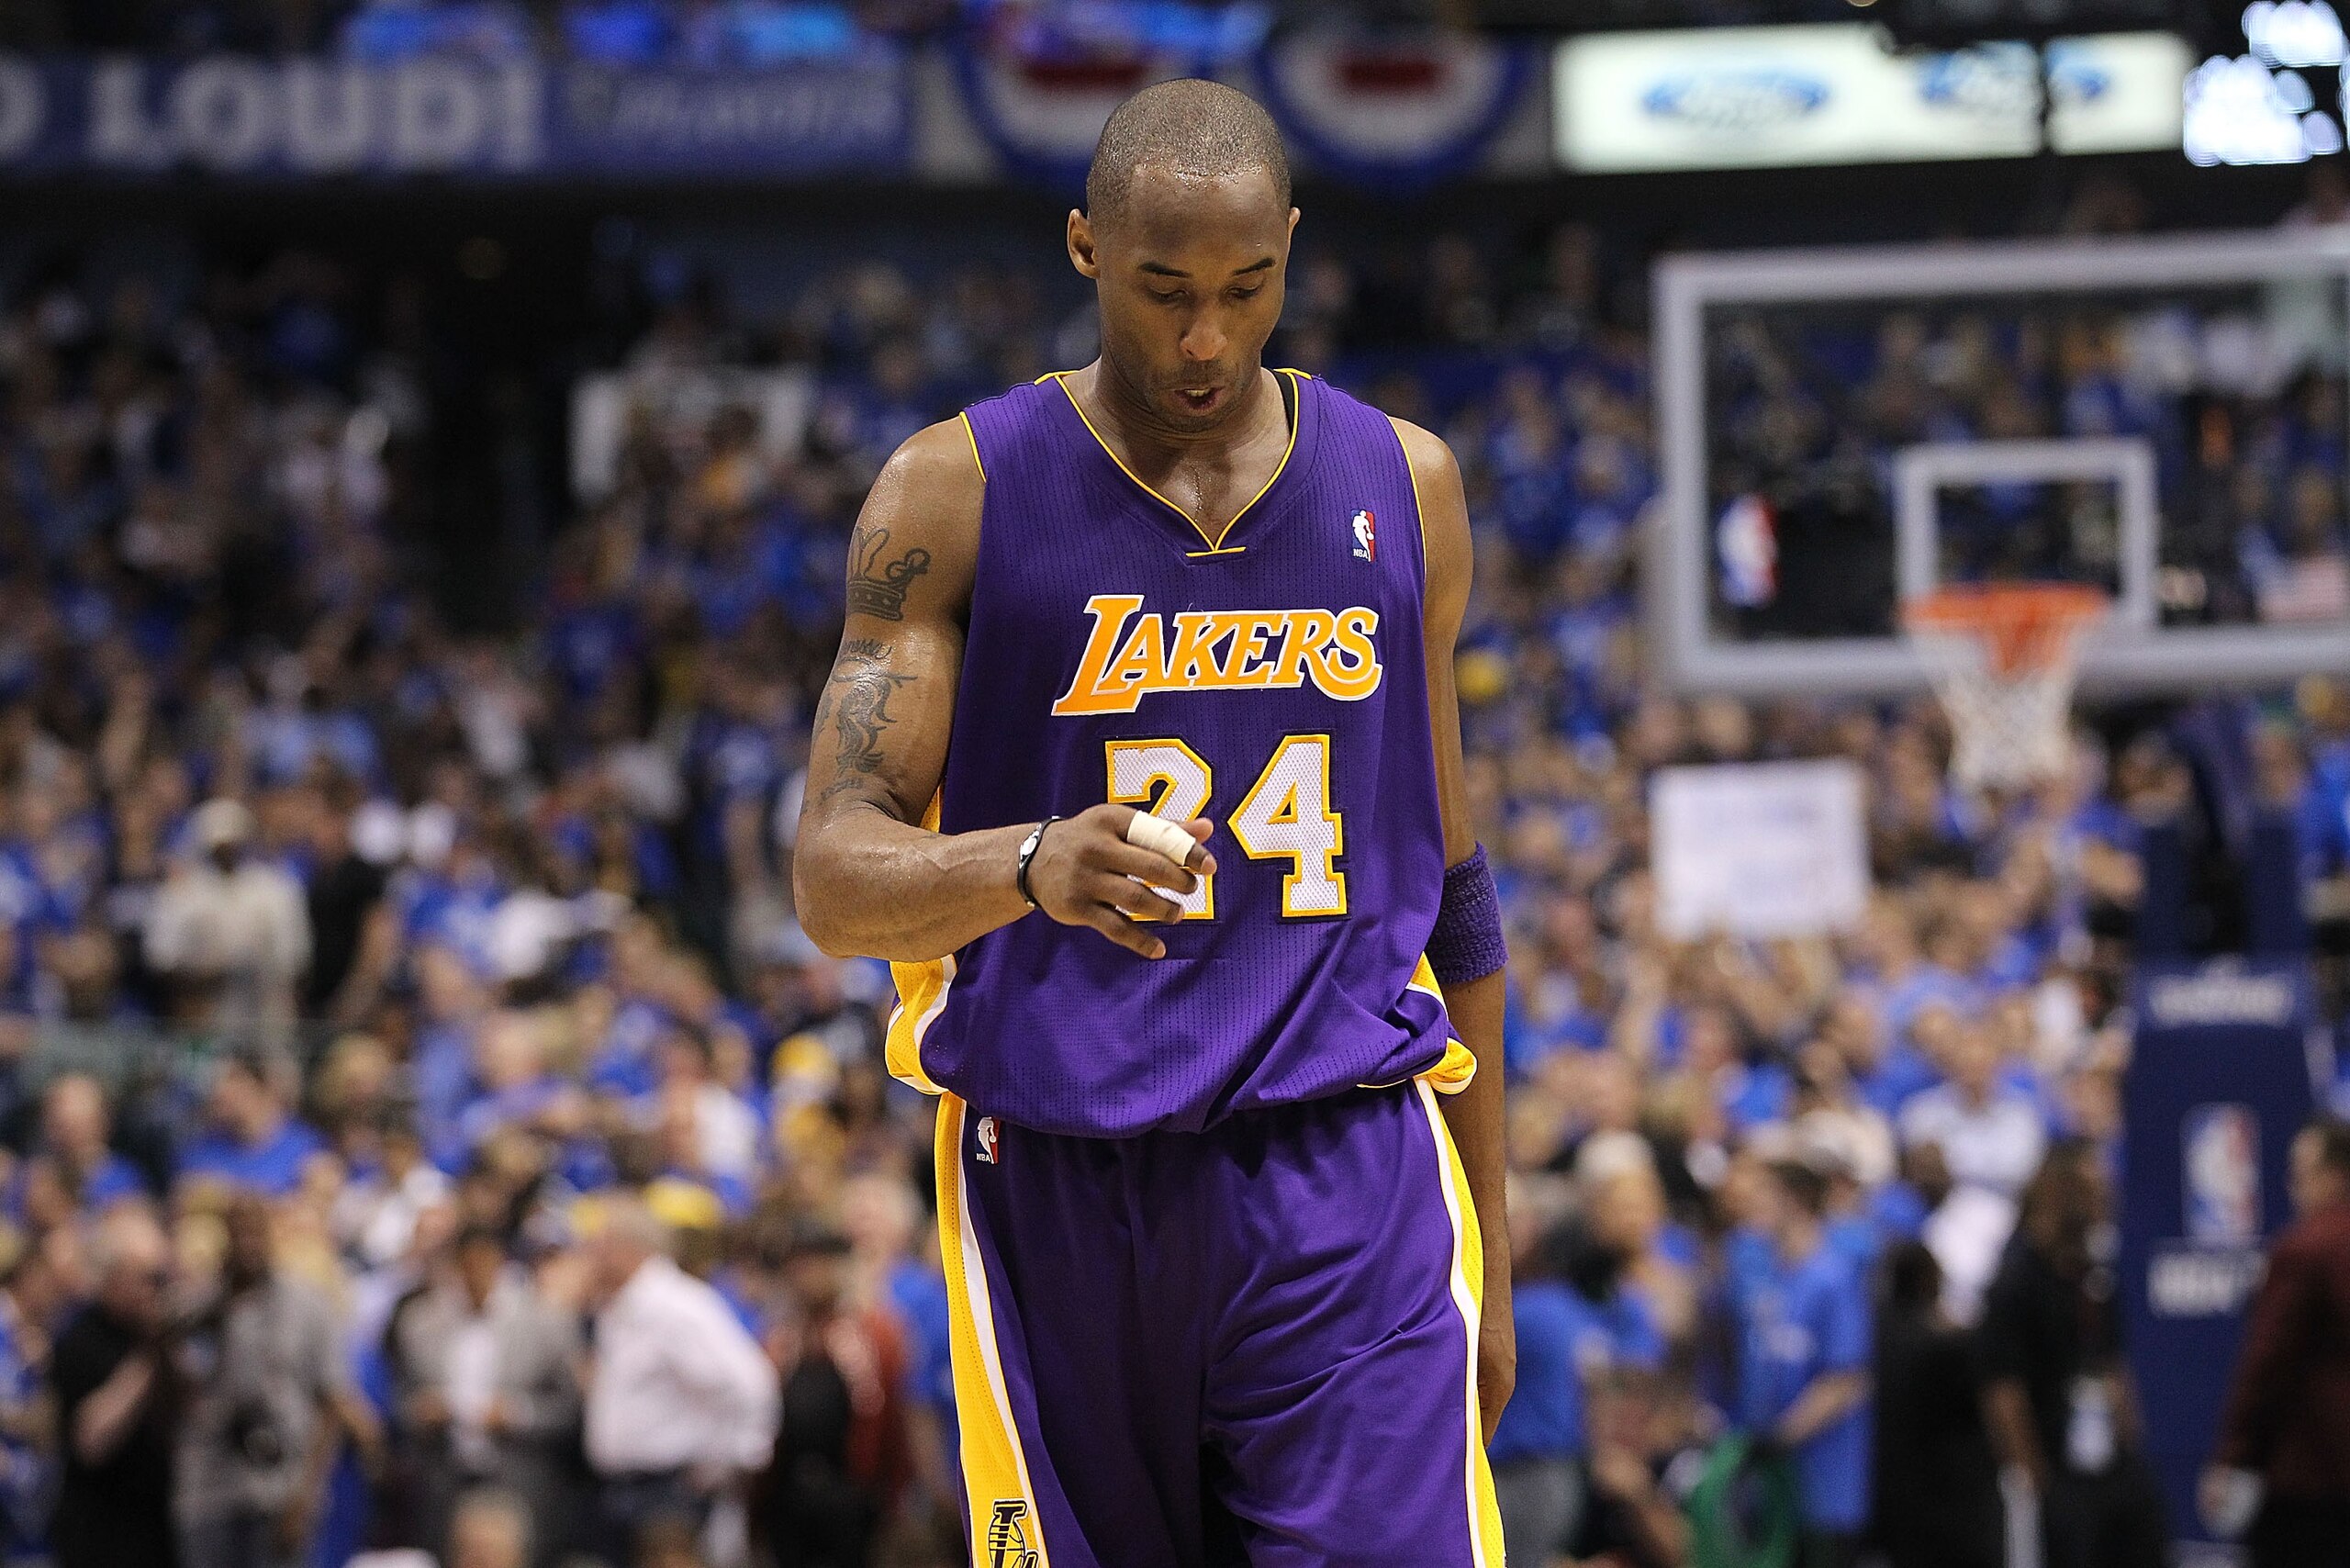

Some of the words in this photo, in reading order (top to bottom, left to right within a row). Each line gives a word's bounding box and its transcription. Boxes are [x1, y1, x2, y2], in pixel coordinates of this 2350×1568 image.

[1353, 548, 1368, 559] NBA
[1051, 595, 1382, 716] LAKERS
[1105, 734, 1347, 921] 24
[976, 1153, 990, 1161] NBA
